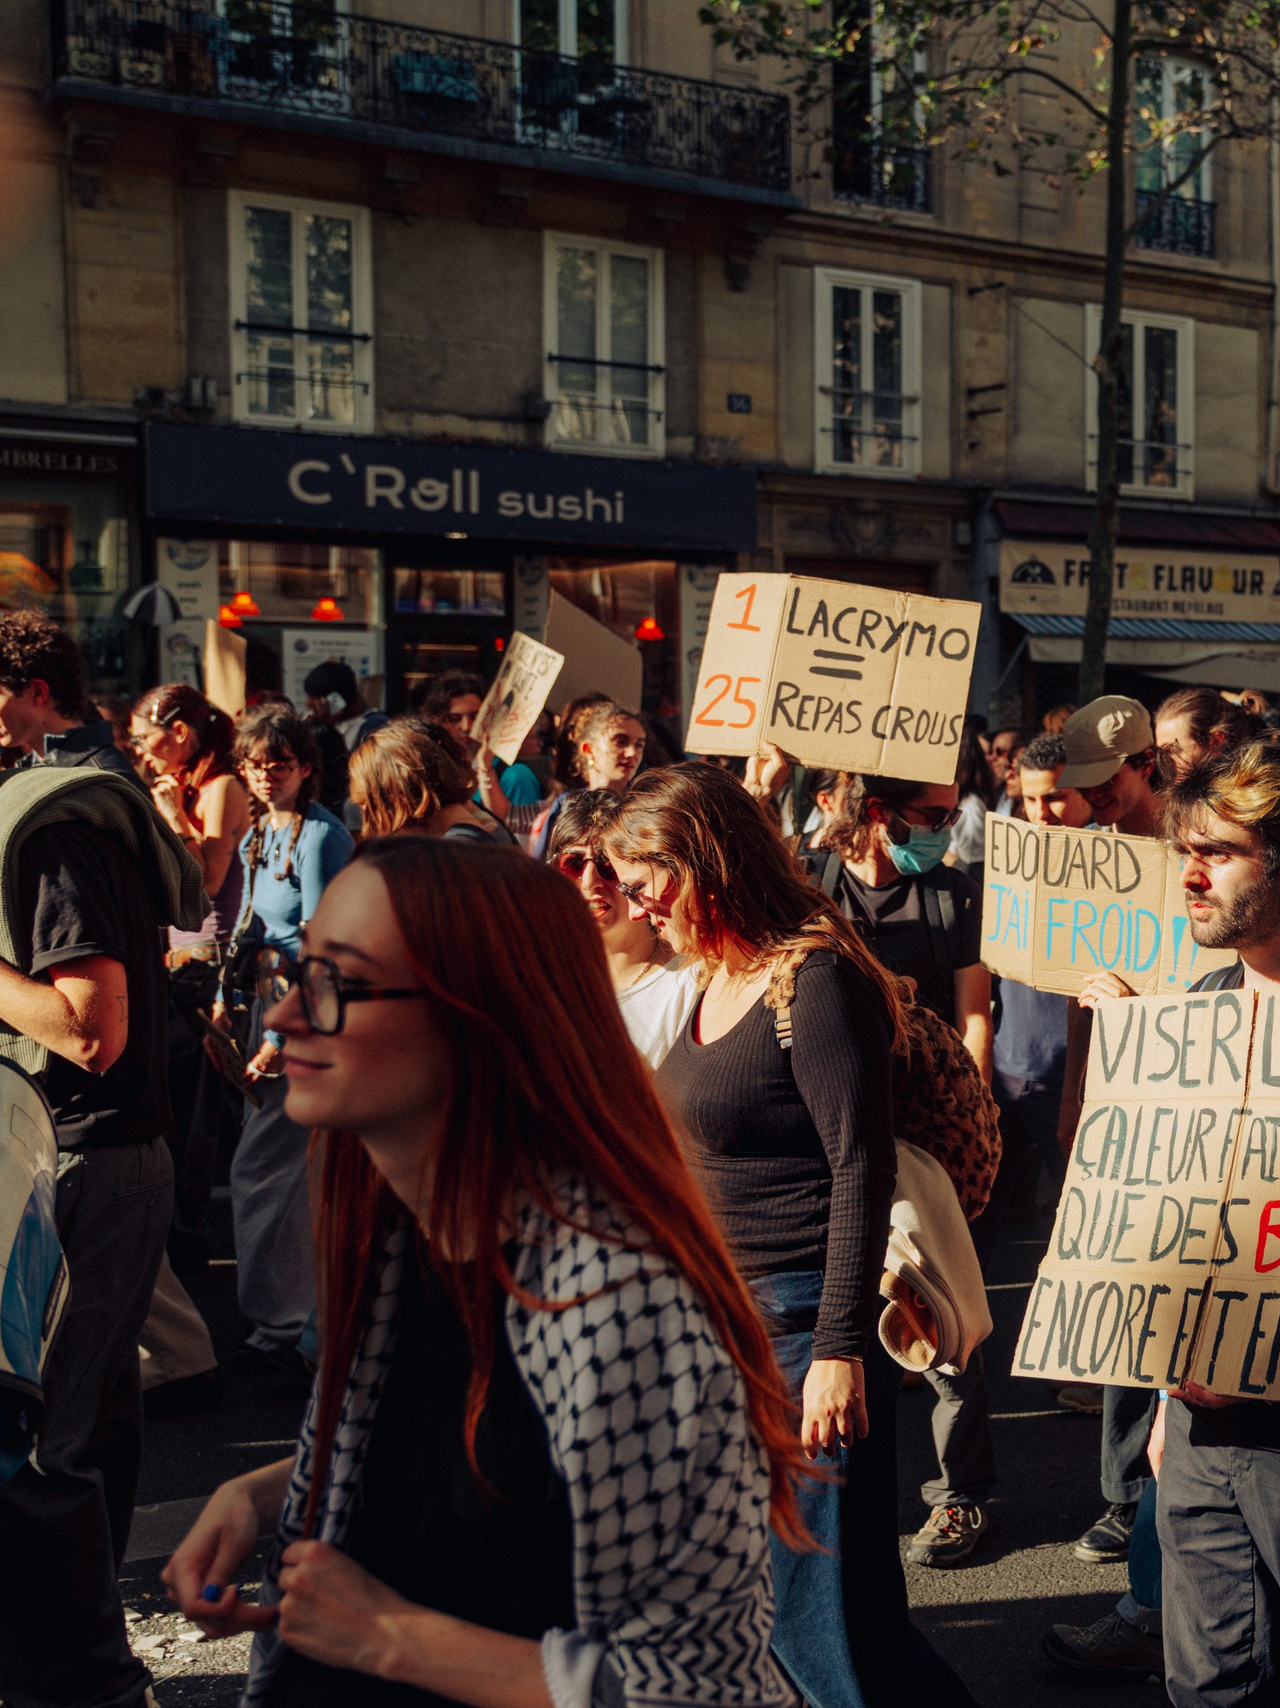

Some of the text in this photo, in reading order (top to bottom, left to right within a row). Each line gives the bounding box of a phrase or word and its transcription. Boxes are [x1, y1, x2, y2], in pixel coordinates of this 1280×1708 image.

[497, 489, 624, 523] sushi
[727, 583, 970, 660] 1 LACRYMO
[695, 674, 963, 746] 25 REPAS CROUS
[991, 819, 1142, 893] EDOUARD
[1097, 992, 1242, 1088] VISER
[1075, 1105, 1128, 1181] ÇA
[1122, 1105, 1217, 1187] LEUR
[1057, 1187, 1146, 1263] QUE
[1148, 1195, 1250, 1267] DES
[1019, 1277, 1171, 1383] ENCORE
[1166, 1287, 1249, 1386] ET
